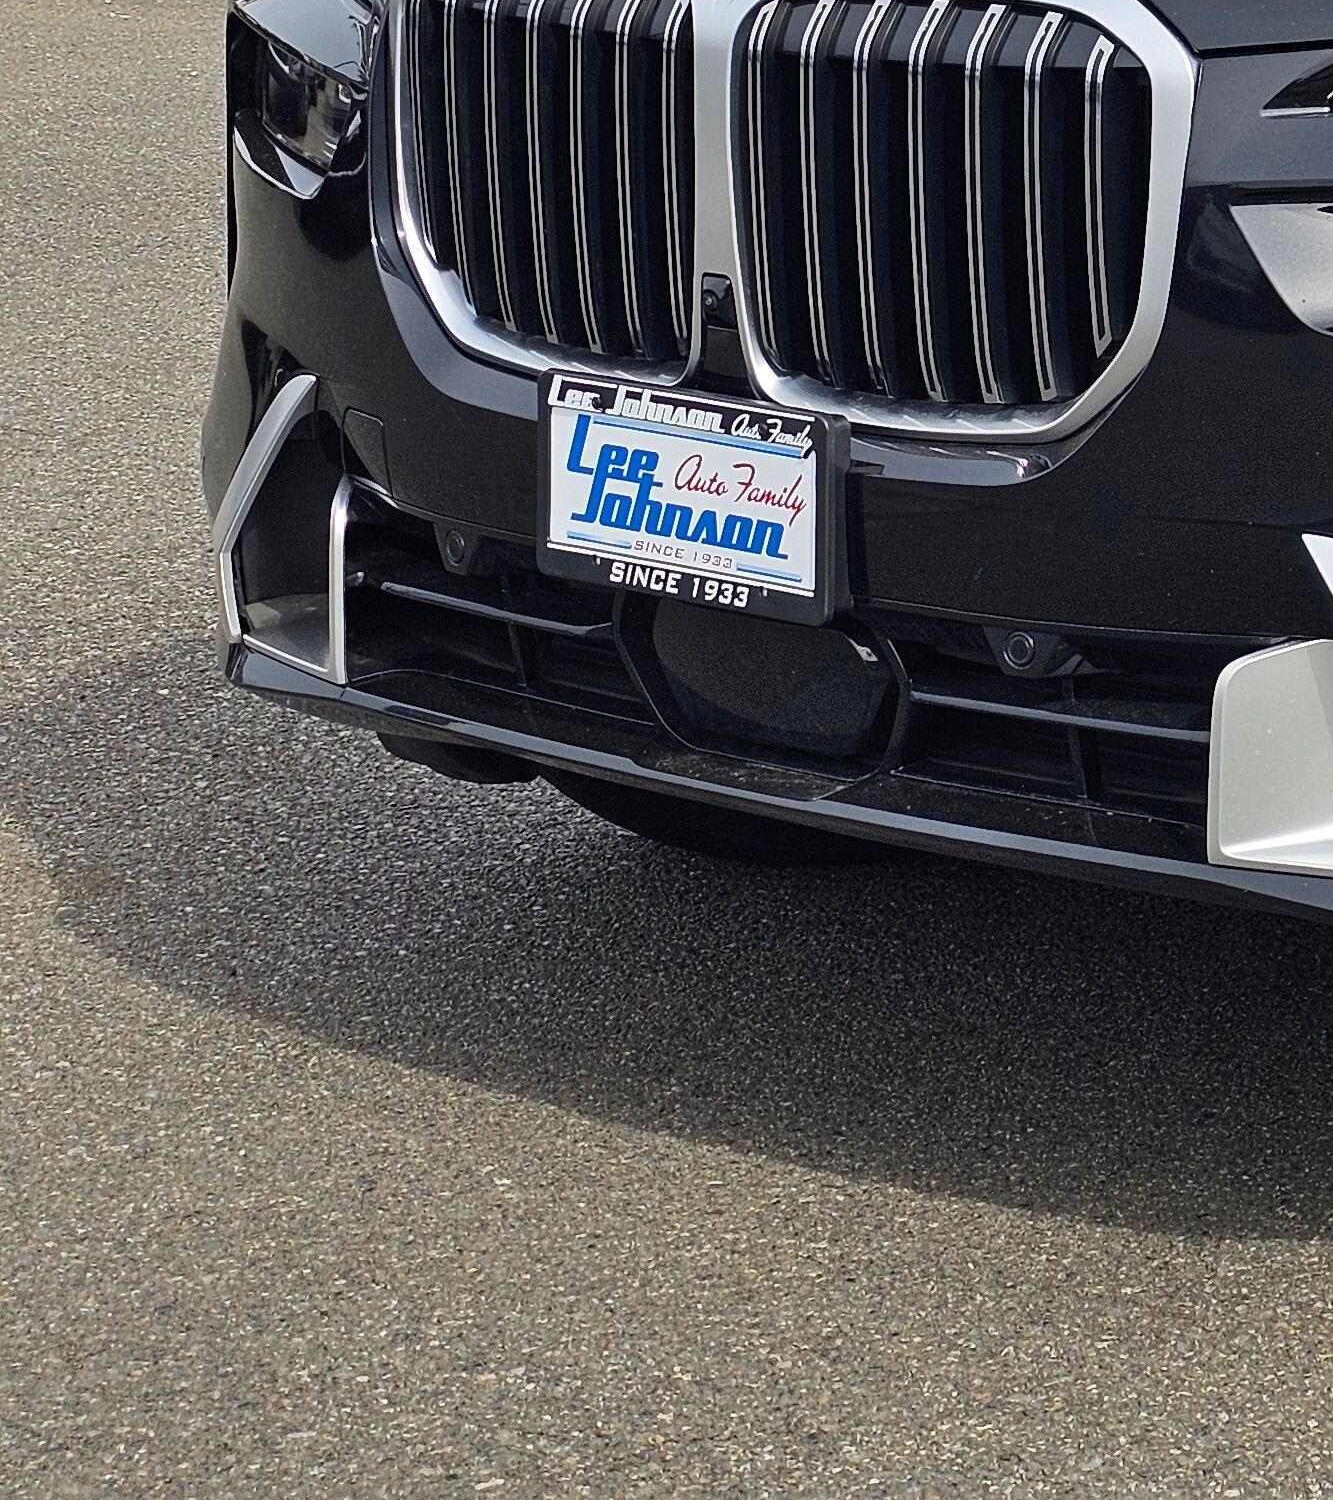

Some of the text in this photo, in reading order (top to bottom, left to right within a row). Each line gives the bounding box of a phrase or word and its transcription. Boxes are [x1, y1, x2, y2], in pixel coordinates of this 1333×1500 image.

[547, 374, 603, 412] Lee
[604, 385, 725, 433] Johnson
[764, 418, 813, 459] Family
[566, 414, 660, 483] Lee
[571, 472, 789, 560] Johnson
[673, 454, 808, 528] Auto Family
[608, 562, 750, 609] SINCE 1933
[633, 539, 734, 570] SINCE 1933
